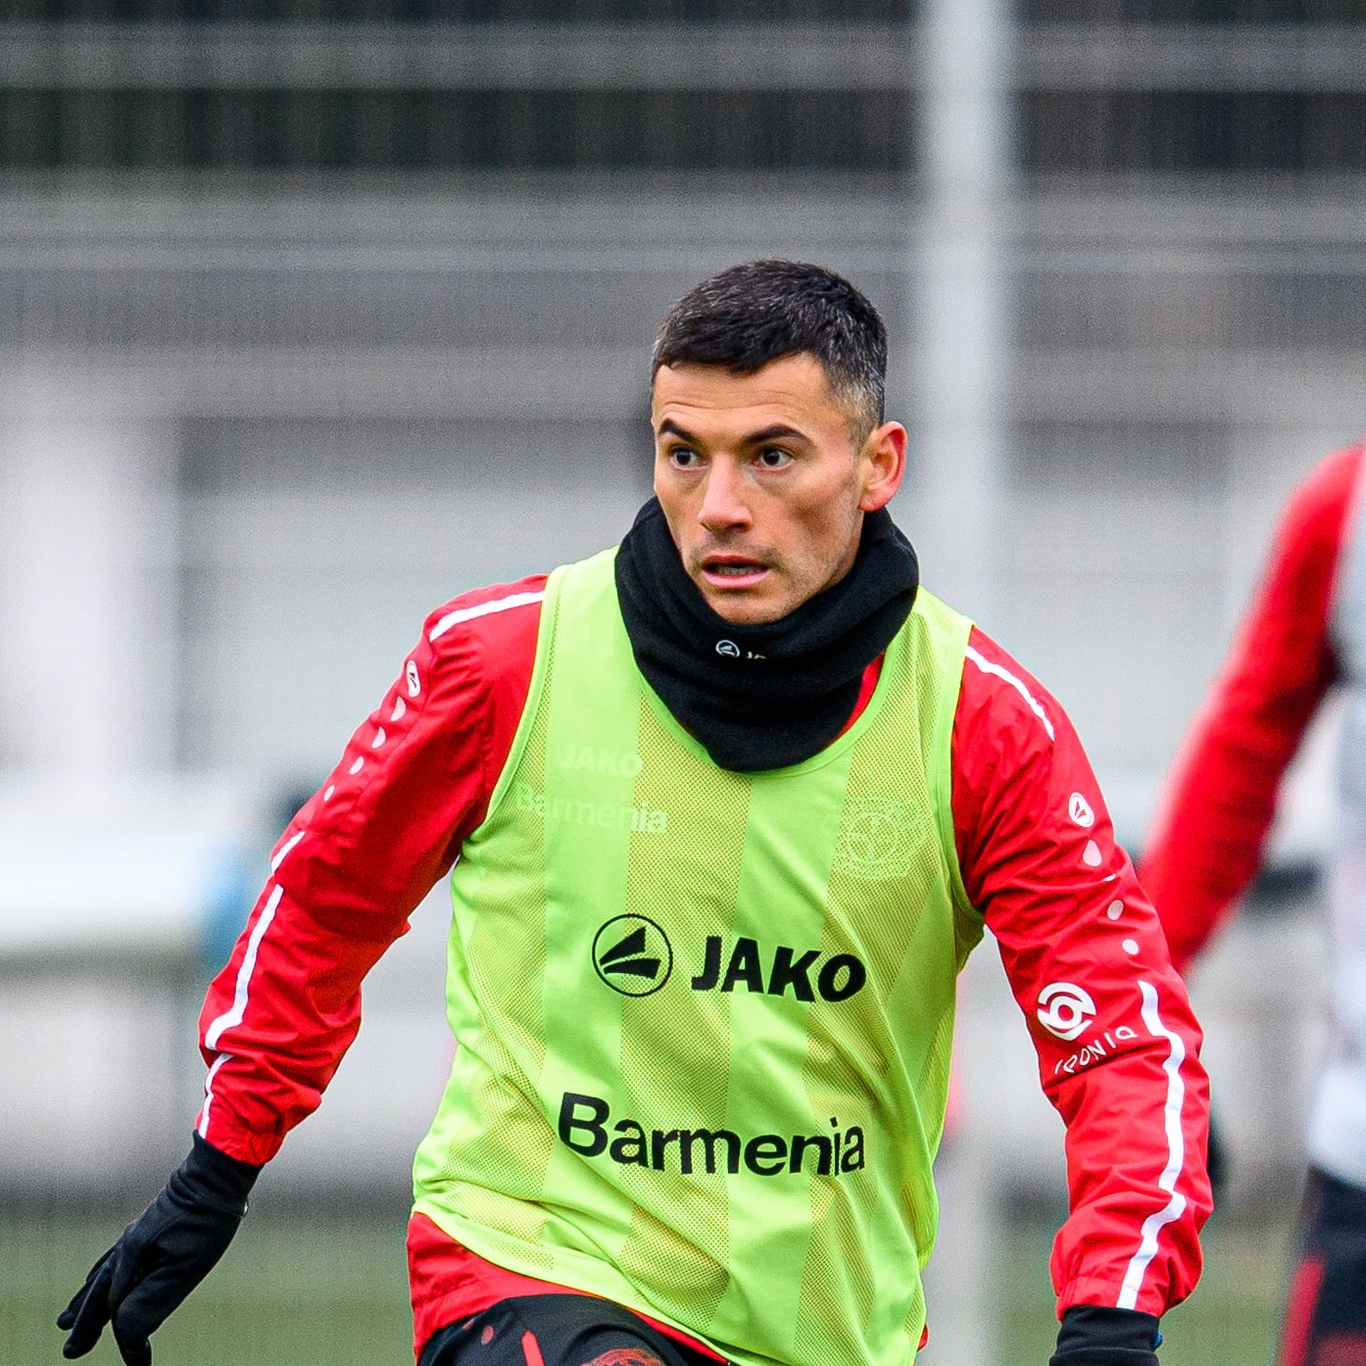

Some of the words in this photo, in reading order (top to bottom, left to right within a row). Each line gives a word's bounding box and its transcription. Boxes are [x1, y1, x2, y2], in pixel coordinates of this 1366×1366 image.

[557, 743, 644, 778] JAKO
[515, 781, 669, 834] Barmenia
[690, 935, 867, 1003] JAKO
[557, 1091, 865, 1177] Barmenia
